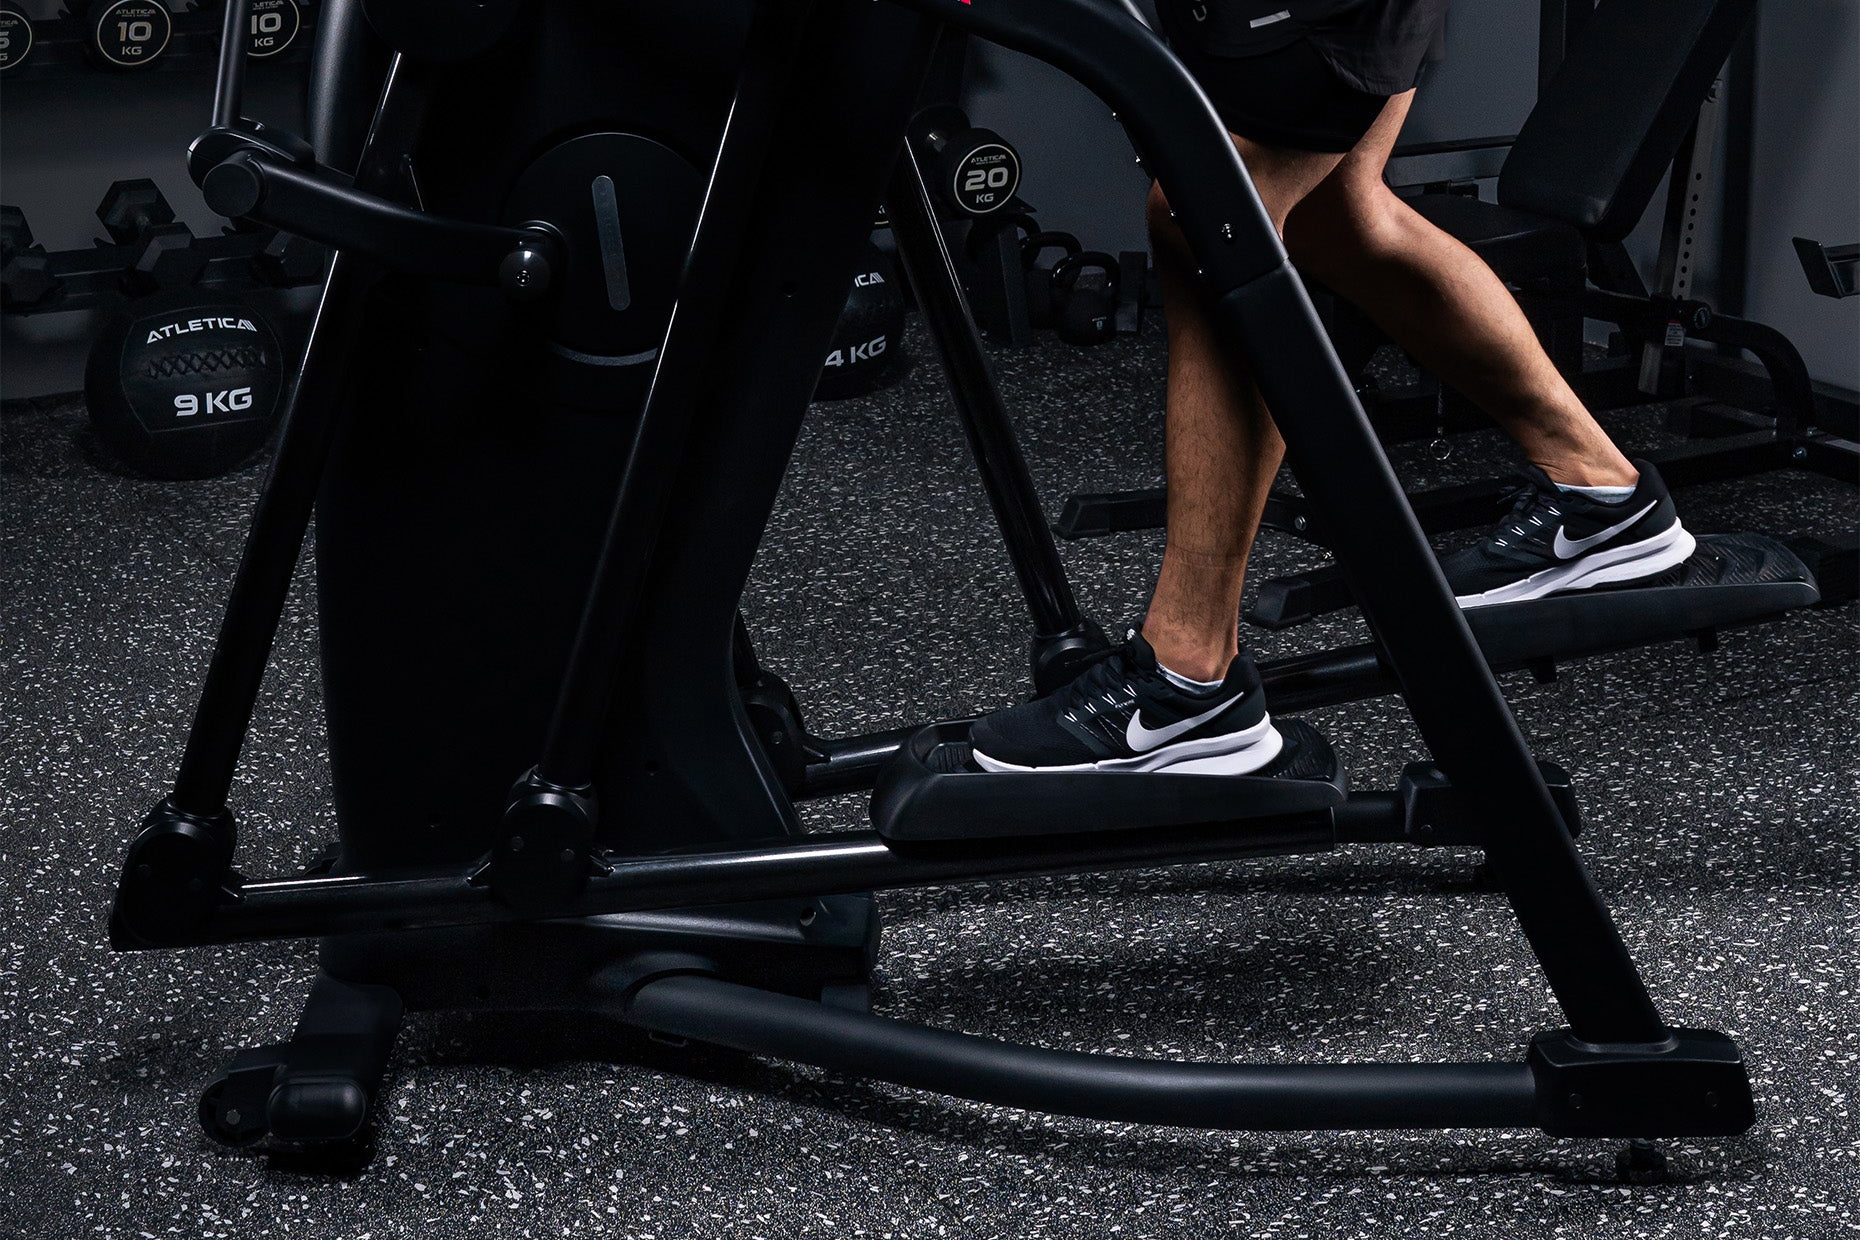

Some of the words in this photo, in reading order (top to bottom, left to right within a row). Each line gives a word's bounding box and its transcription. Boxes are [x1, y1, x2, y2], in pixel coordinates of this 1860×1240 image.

[117, 22, 153, 41] 10
[254, 37, 275, 47] KG
[122, 46, 143, 55] KG
[965, 167, 1009, 191] 20
[976, 193, 995, 204] KG
[146, 317, 258, 345] ATLETICA
[824, 349, 845, 367] 4
[850, 334, 887, 364] KG
[173, 393, 199, 417] 9
[205, 386, 253, 415] KG
